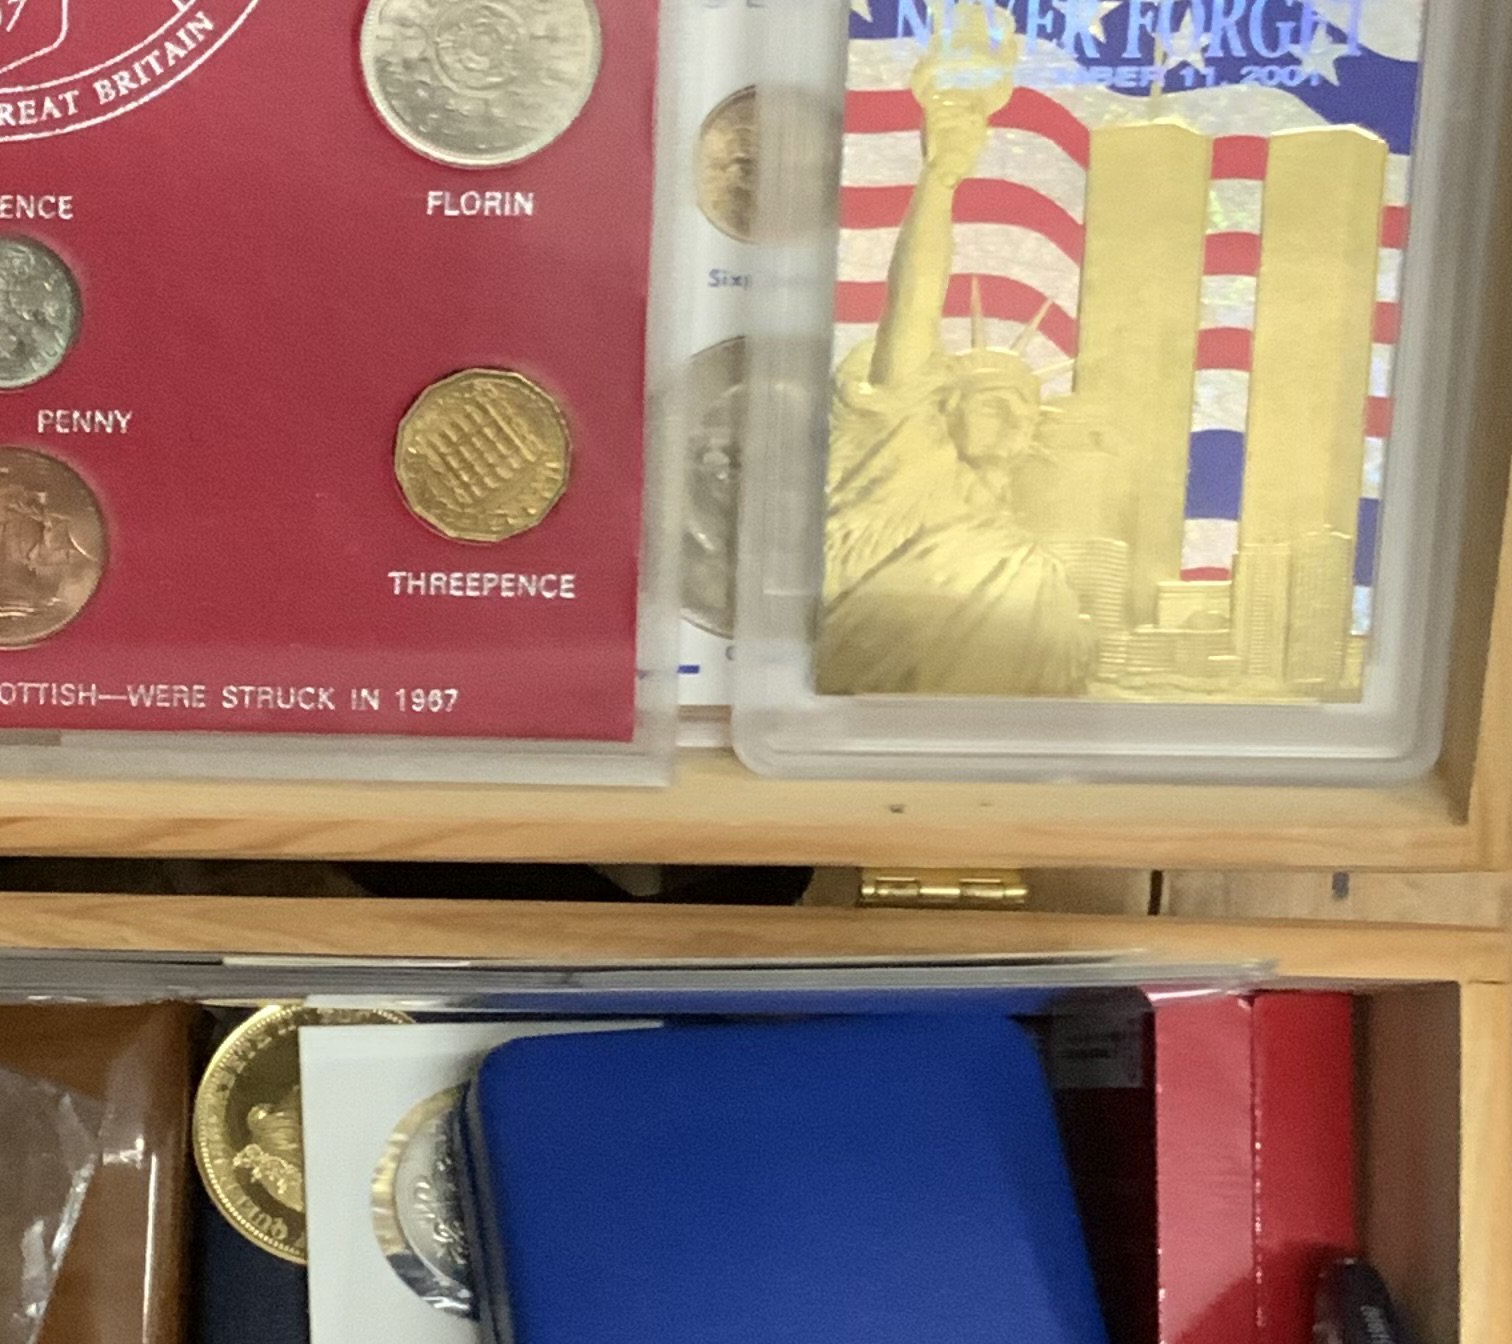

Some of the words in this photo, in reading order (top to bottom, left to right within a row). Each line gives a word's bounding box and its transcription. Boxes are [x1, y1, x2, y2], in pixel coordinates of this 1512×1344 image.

[92, 10, 216, 107] BRITAIN
[426, 190, 535, 217] FLORIN
[37, 409, 133, 434] PENNY
[388, 571, 576, 598] THREEPENCE
[221, 685, 335, 712] STRUCK
[350, 688, 380, 711] IN
[394, 687, 458, 713] 1967
